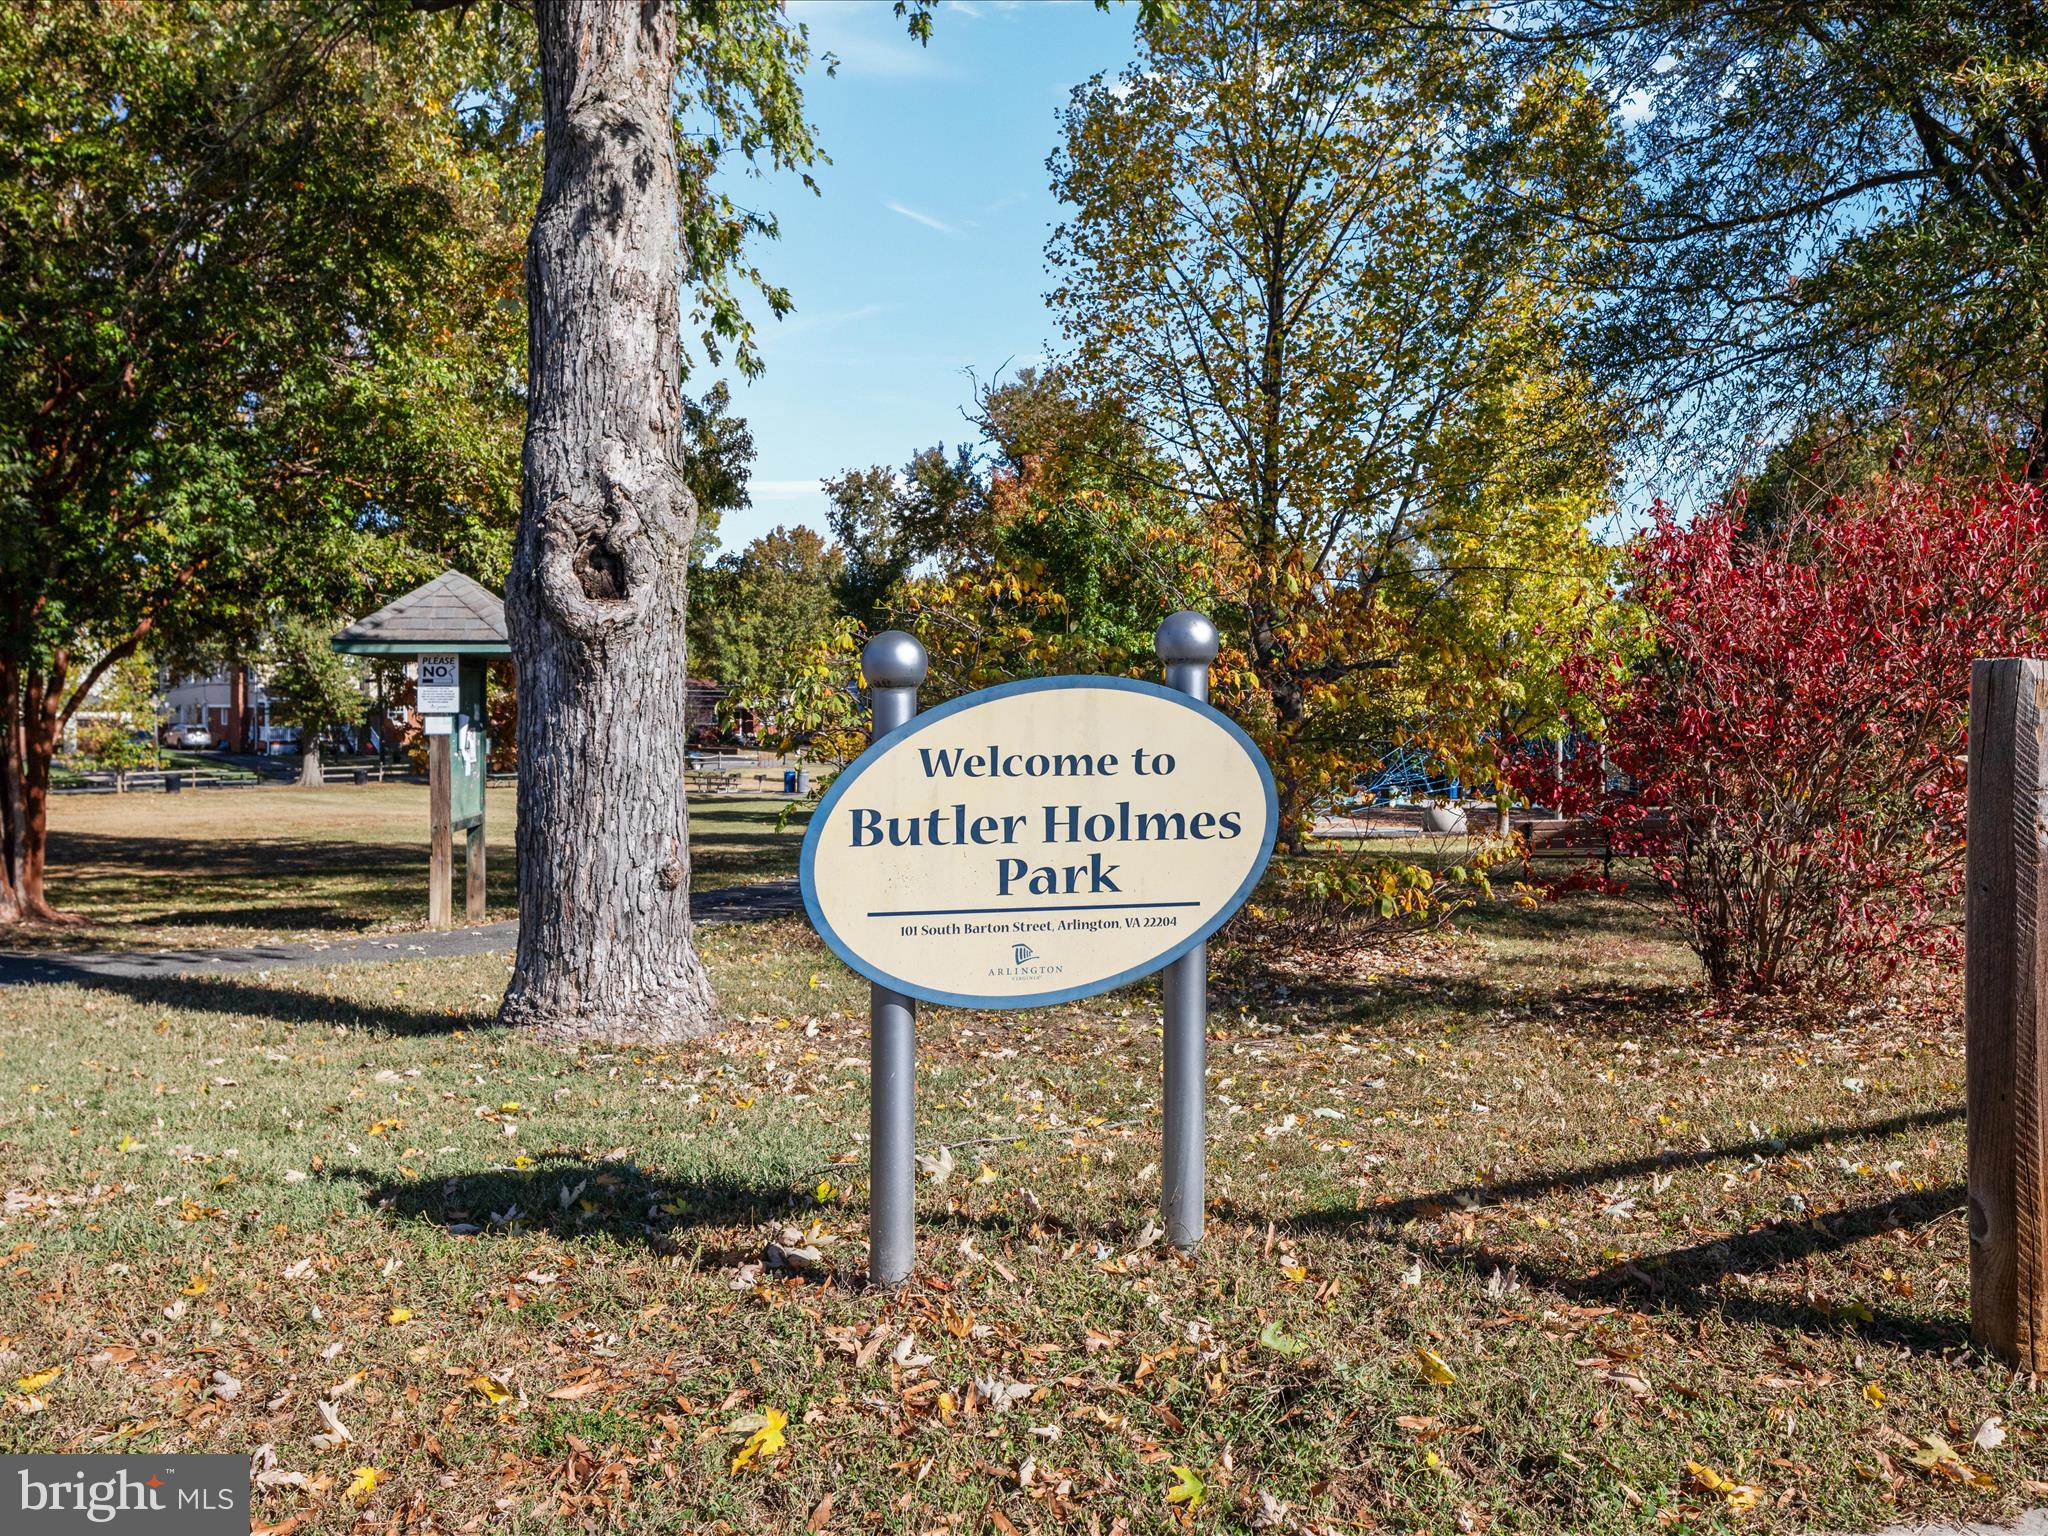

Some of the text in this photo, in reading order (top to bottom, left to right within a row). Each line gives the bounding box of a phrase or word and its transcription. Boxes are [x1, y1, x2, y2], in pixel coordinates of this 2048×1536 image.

[422, 656, 455, 664] PLEASE
[423, 666, 447, 677] NO
[918, 745, 1176, 778] Welcome to
[848, 801, 1242, 848] Butler Holmes
[996, 853, 1123, 897] Park
[900, 916, 1177, 937] 101 South Barton Street, Arlington, VA 22204
[987, 965, 1064, 977] ARLINGTON
